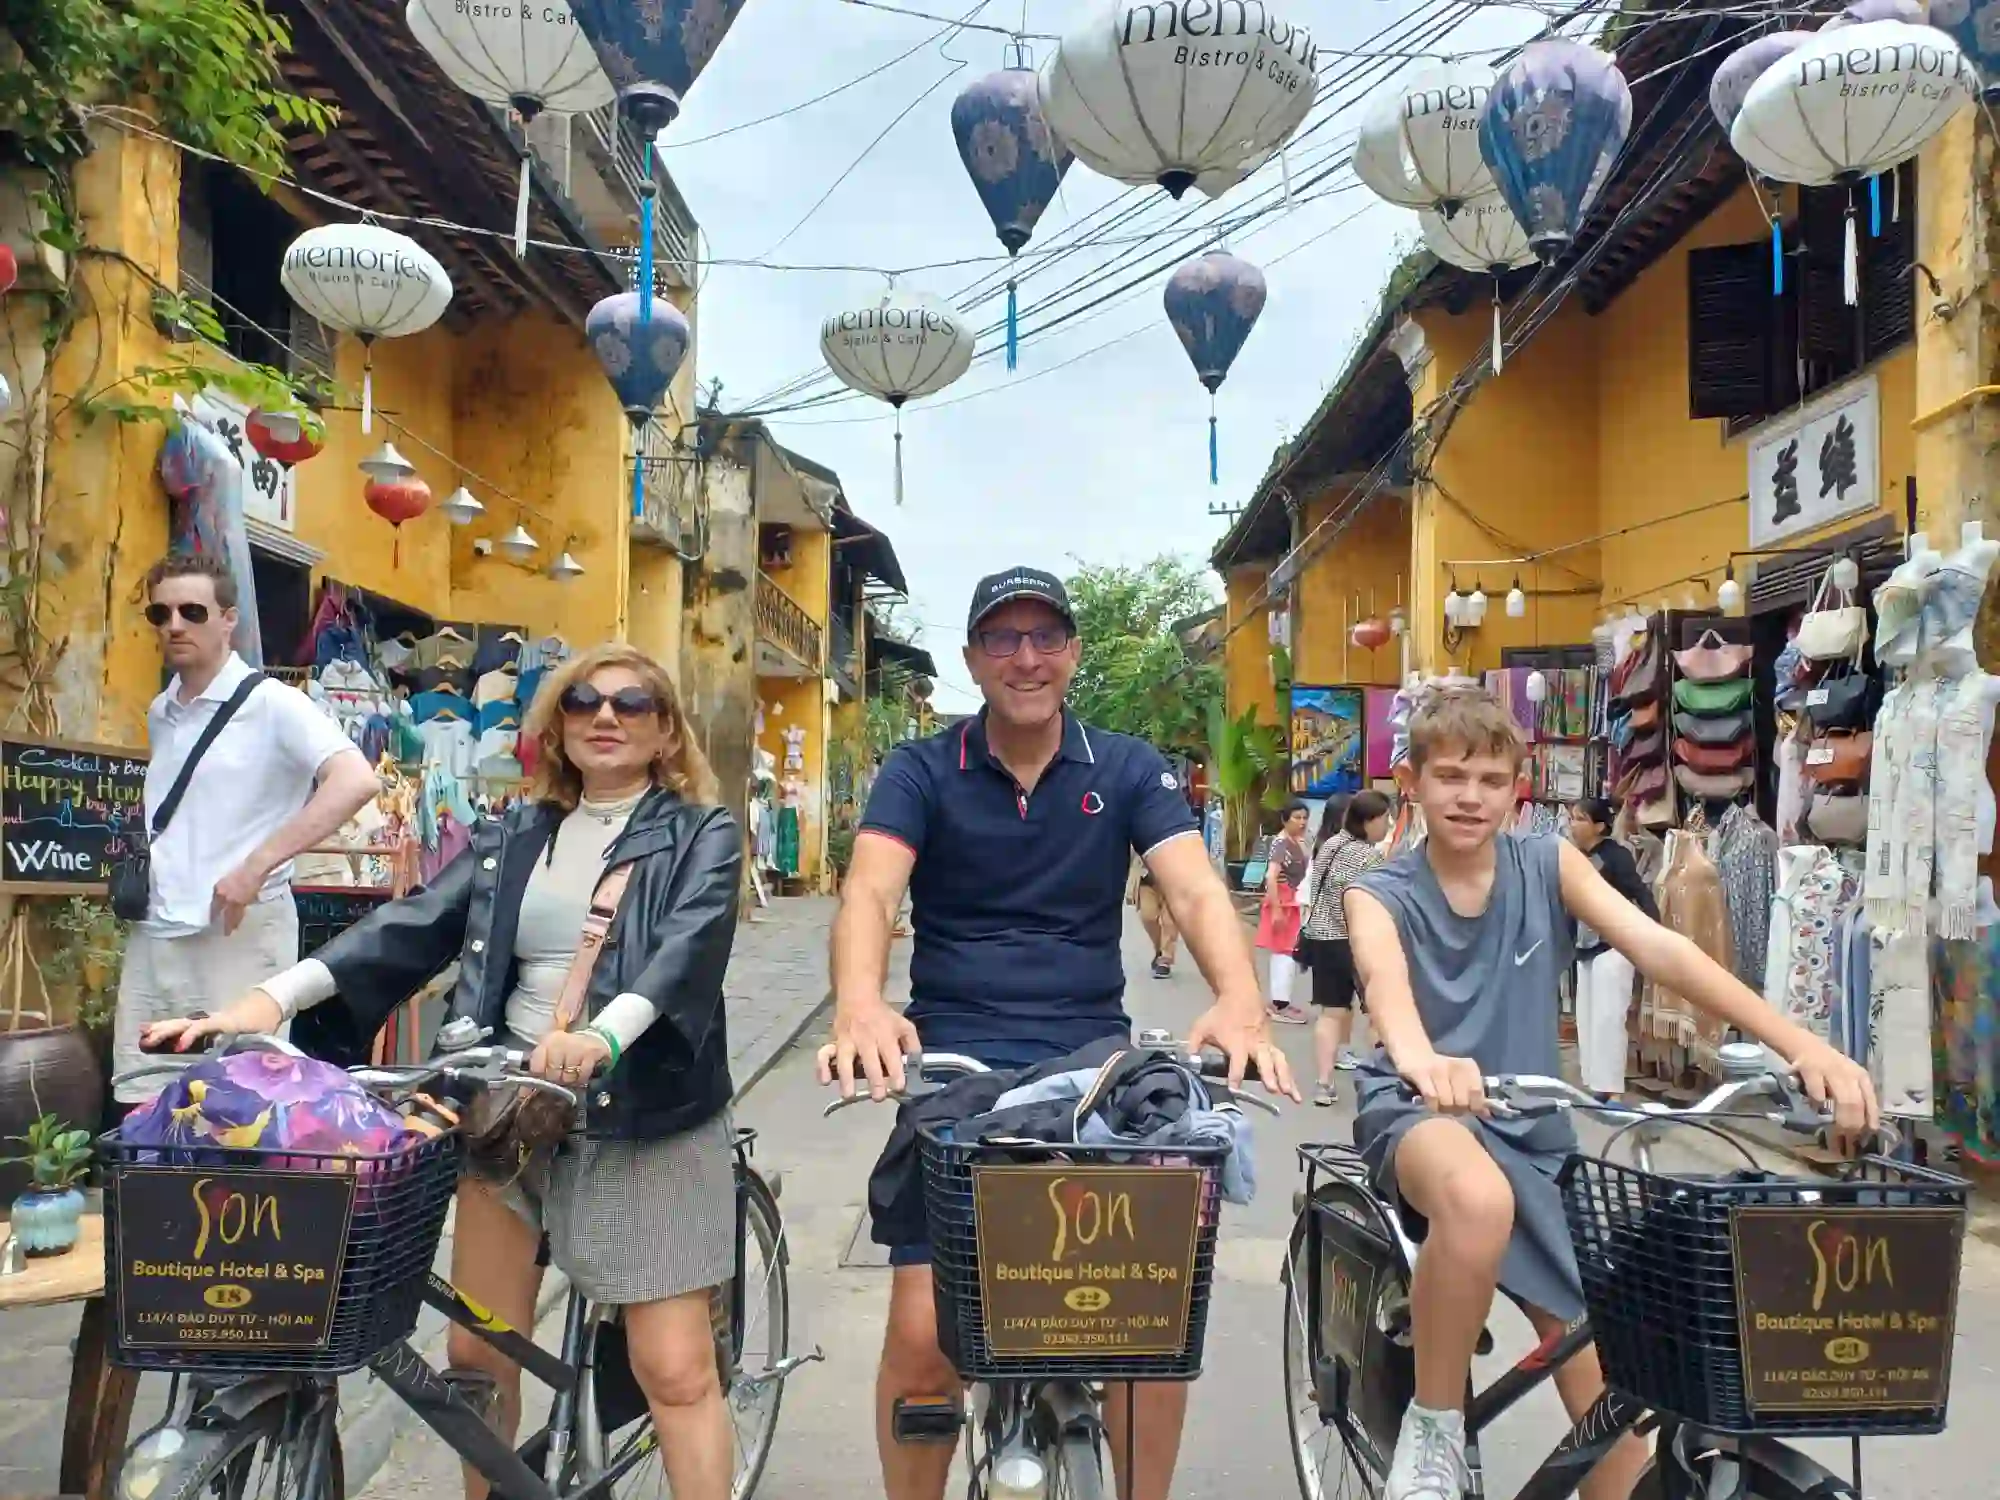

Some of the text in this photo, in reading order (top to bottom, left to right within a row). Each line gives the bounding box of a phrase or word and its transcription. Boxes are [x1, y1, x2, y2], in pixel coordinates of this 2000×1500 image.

[1174, 46, 1299, 94] Bistro & Café
[1839, 82, 1900, 98] Bistro
[1906, 77, 1917, 94] &
[288, 245, 431, 282] memories
[821, 304, 955, 339] memories
[3, 765, 84, 808] Happy
[5, 839, 92, 873] Wine
[133, 1260, 325, 1284] Boutique Hotel & Spa
[996, 1262, 1178, 1285] Boutique Hotel & Spa
[208, 1314, 236, 1325] DUY
[294, 1315, 314, 1325] AN
